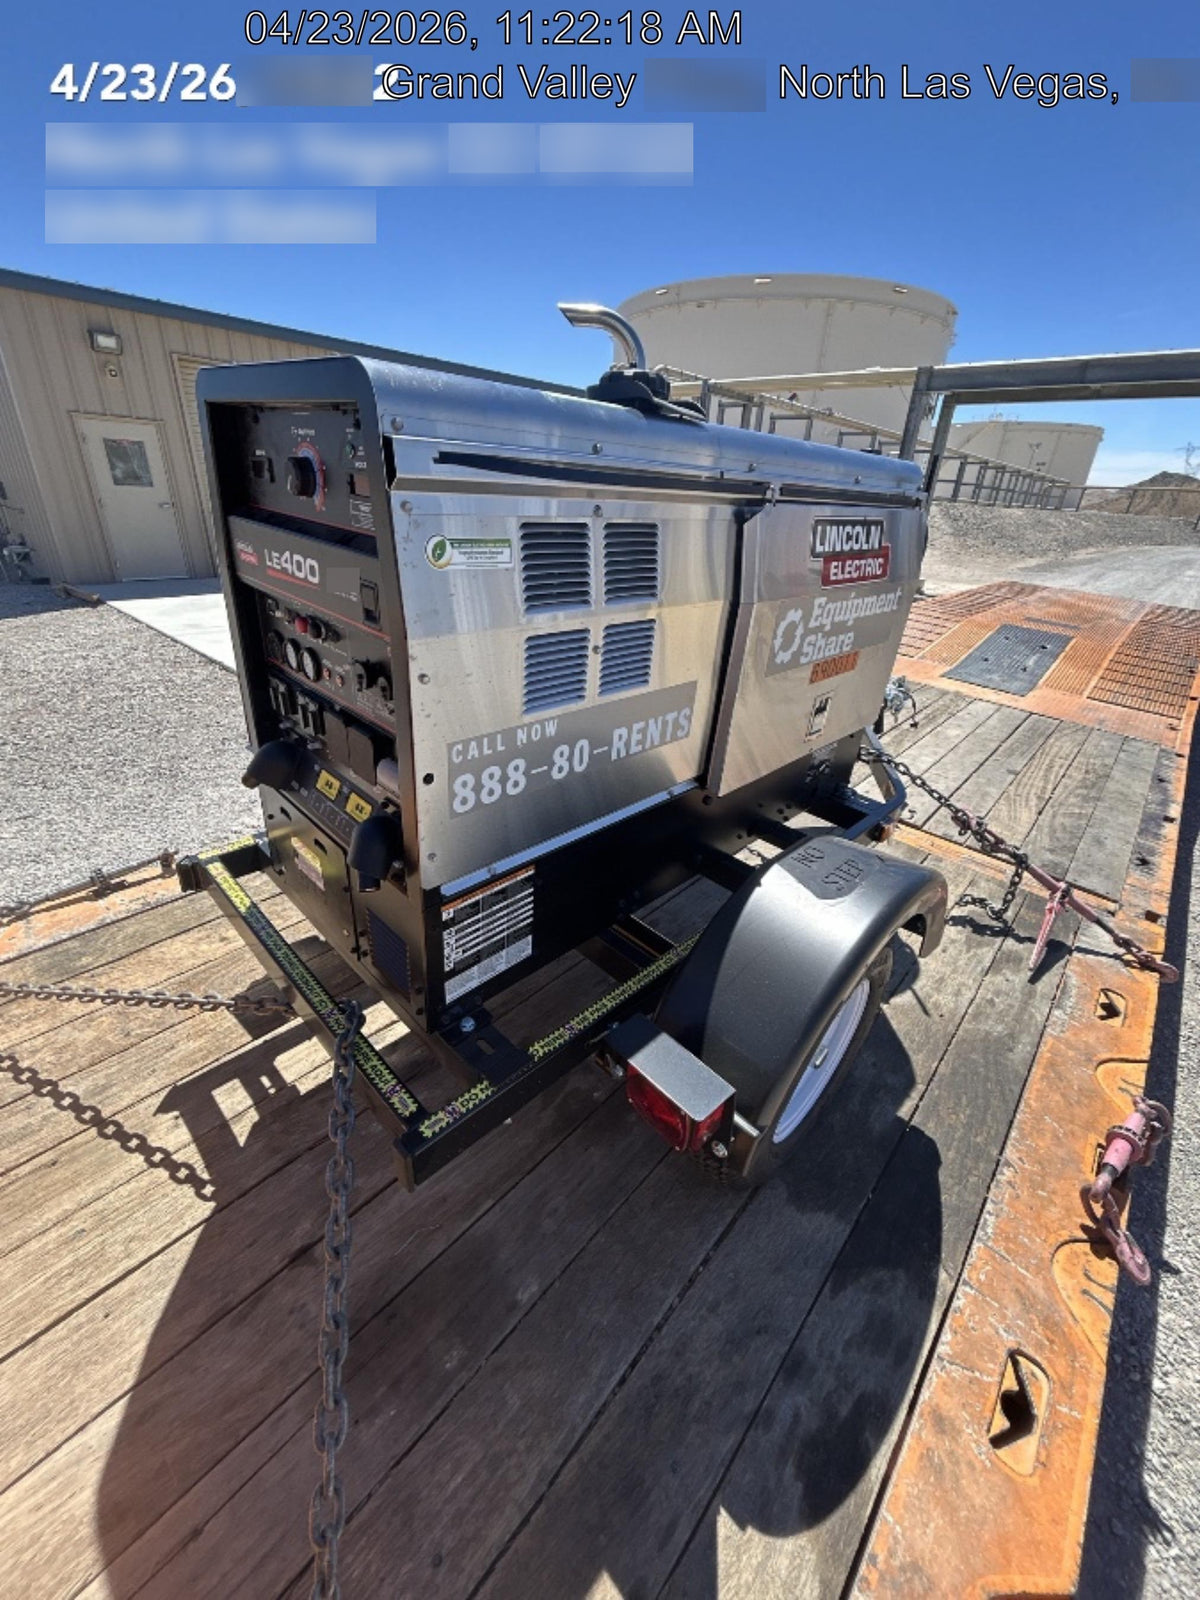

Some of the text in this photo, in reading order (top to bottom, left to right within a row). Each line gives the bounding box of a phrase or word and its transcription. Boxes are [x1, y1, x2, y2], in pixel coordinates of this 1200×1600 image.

[814, 524, 882, 554] LINCOLN
[263, 548, 320, 585] LE400
[828, 557, 885, 581] ELECTRIC
[807, 586, 903, 632] Equipment
[800, 630, 855, 665] Share
[451, 718, 558, 765] CALL NOW
[451, 706, 693, 814] 888-80-RENTS
